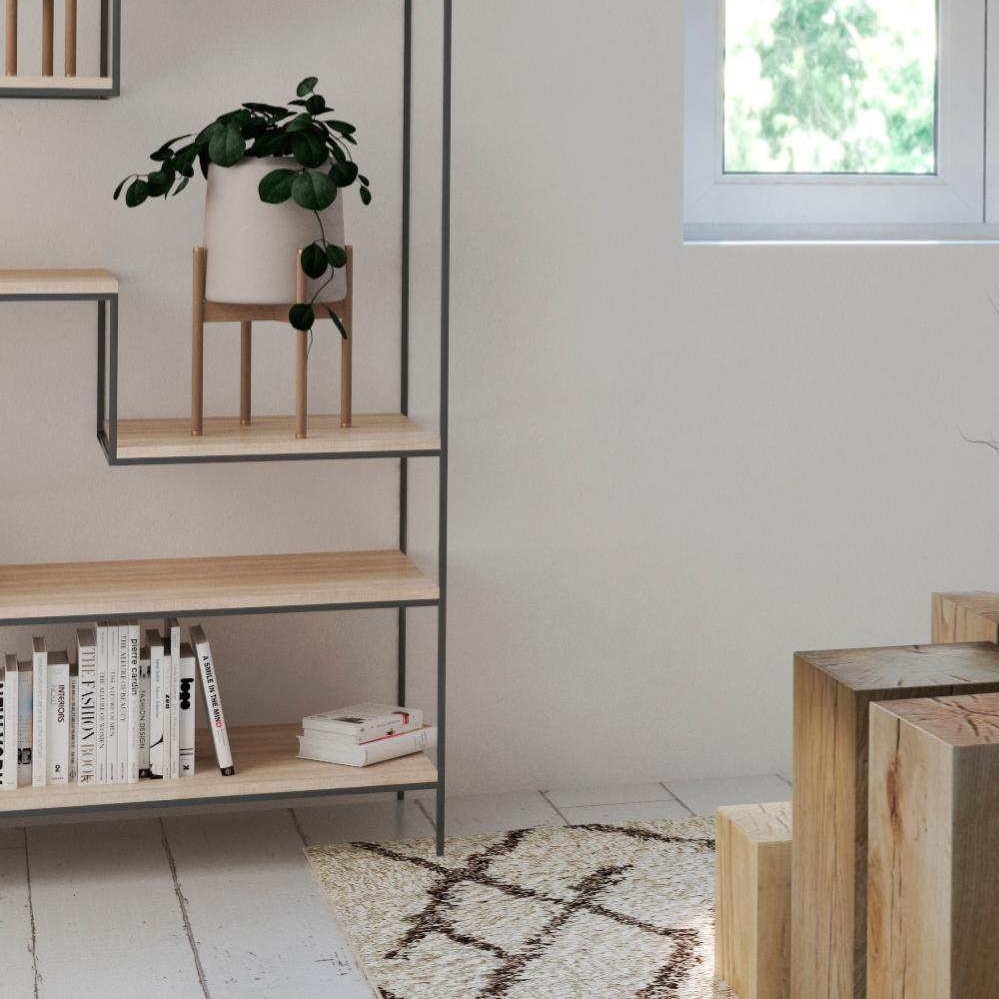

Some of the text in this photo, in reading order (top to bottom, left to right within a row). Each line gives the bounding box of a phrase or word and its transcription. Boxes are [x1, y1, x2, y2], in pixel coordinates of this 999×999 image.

[81, 648, 96, 676] THE
[130, 638, 139, 696] pierre cardin
[204, 662, 214, 683] SMILE
[179, 678, 195, 710] logo
[207, 685, 216, 693] IN
[210, 693, 219, 707] THE
[57, 684, 65, 724] INTERIORS
[81, 681, 95, 740] FASHION
[213, 708, 222, 729] MIND
